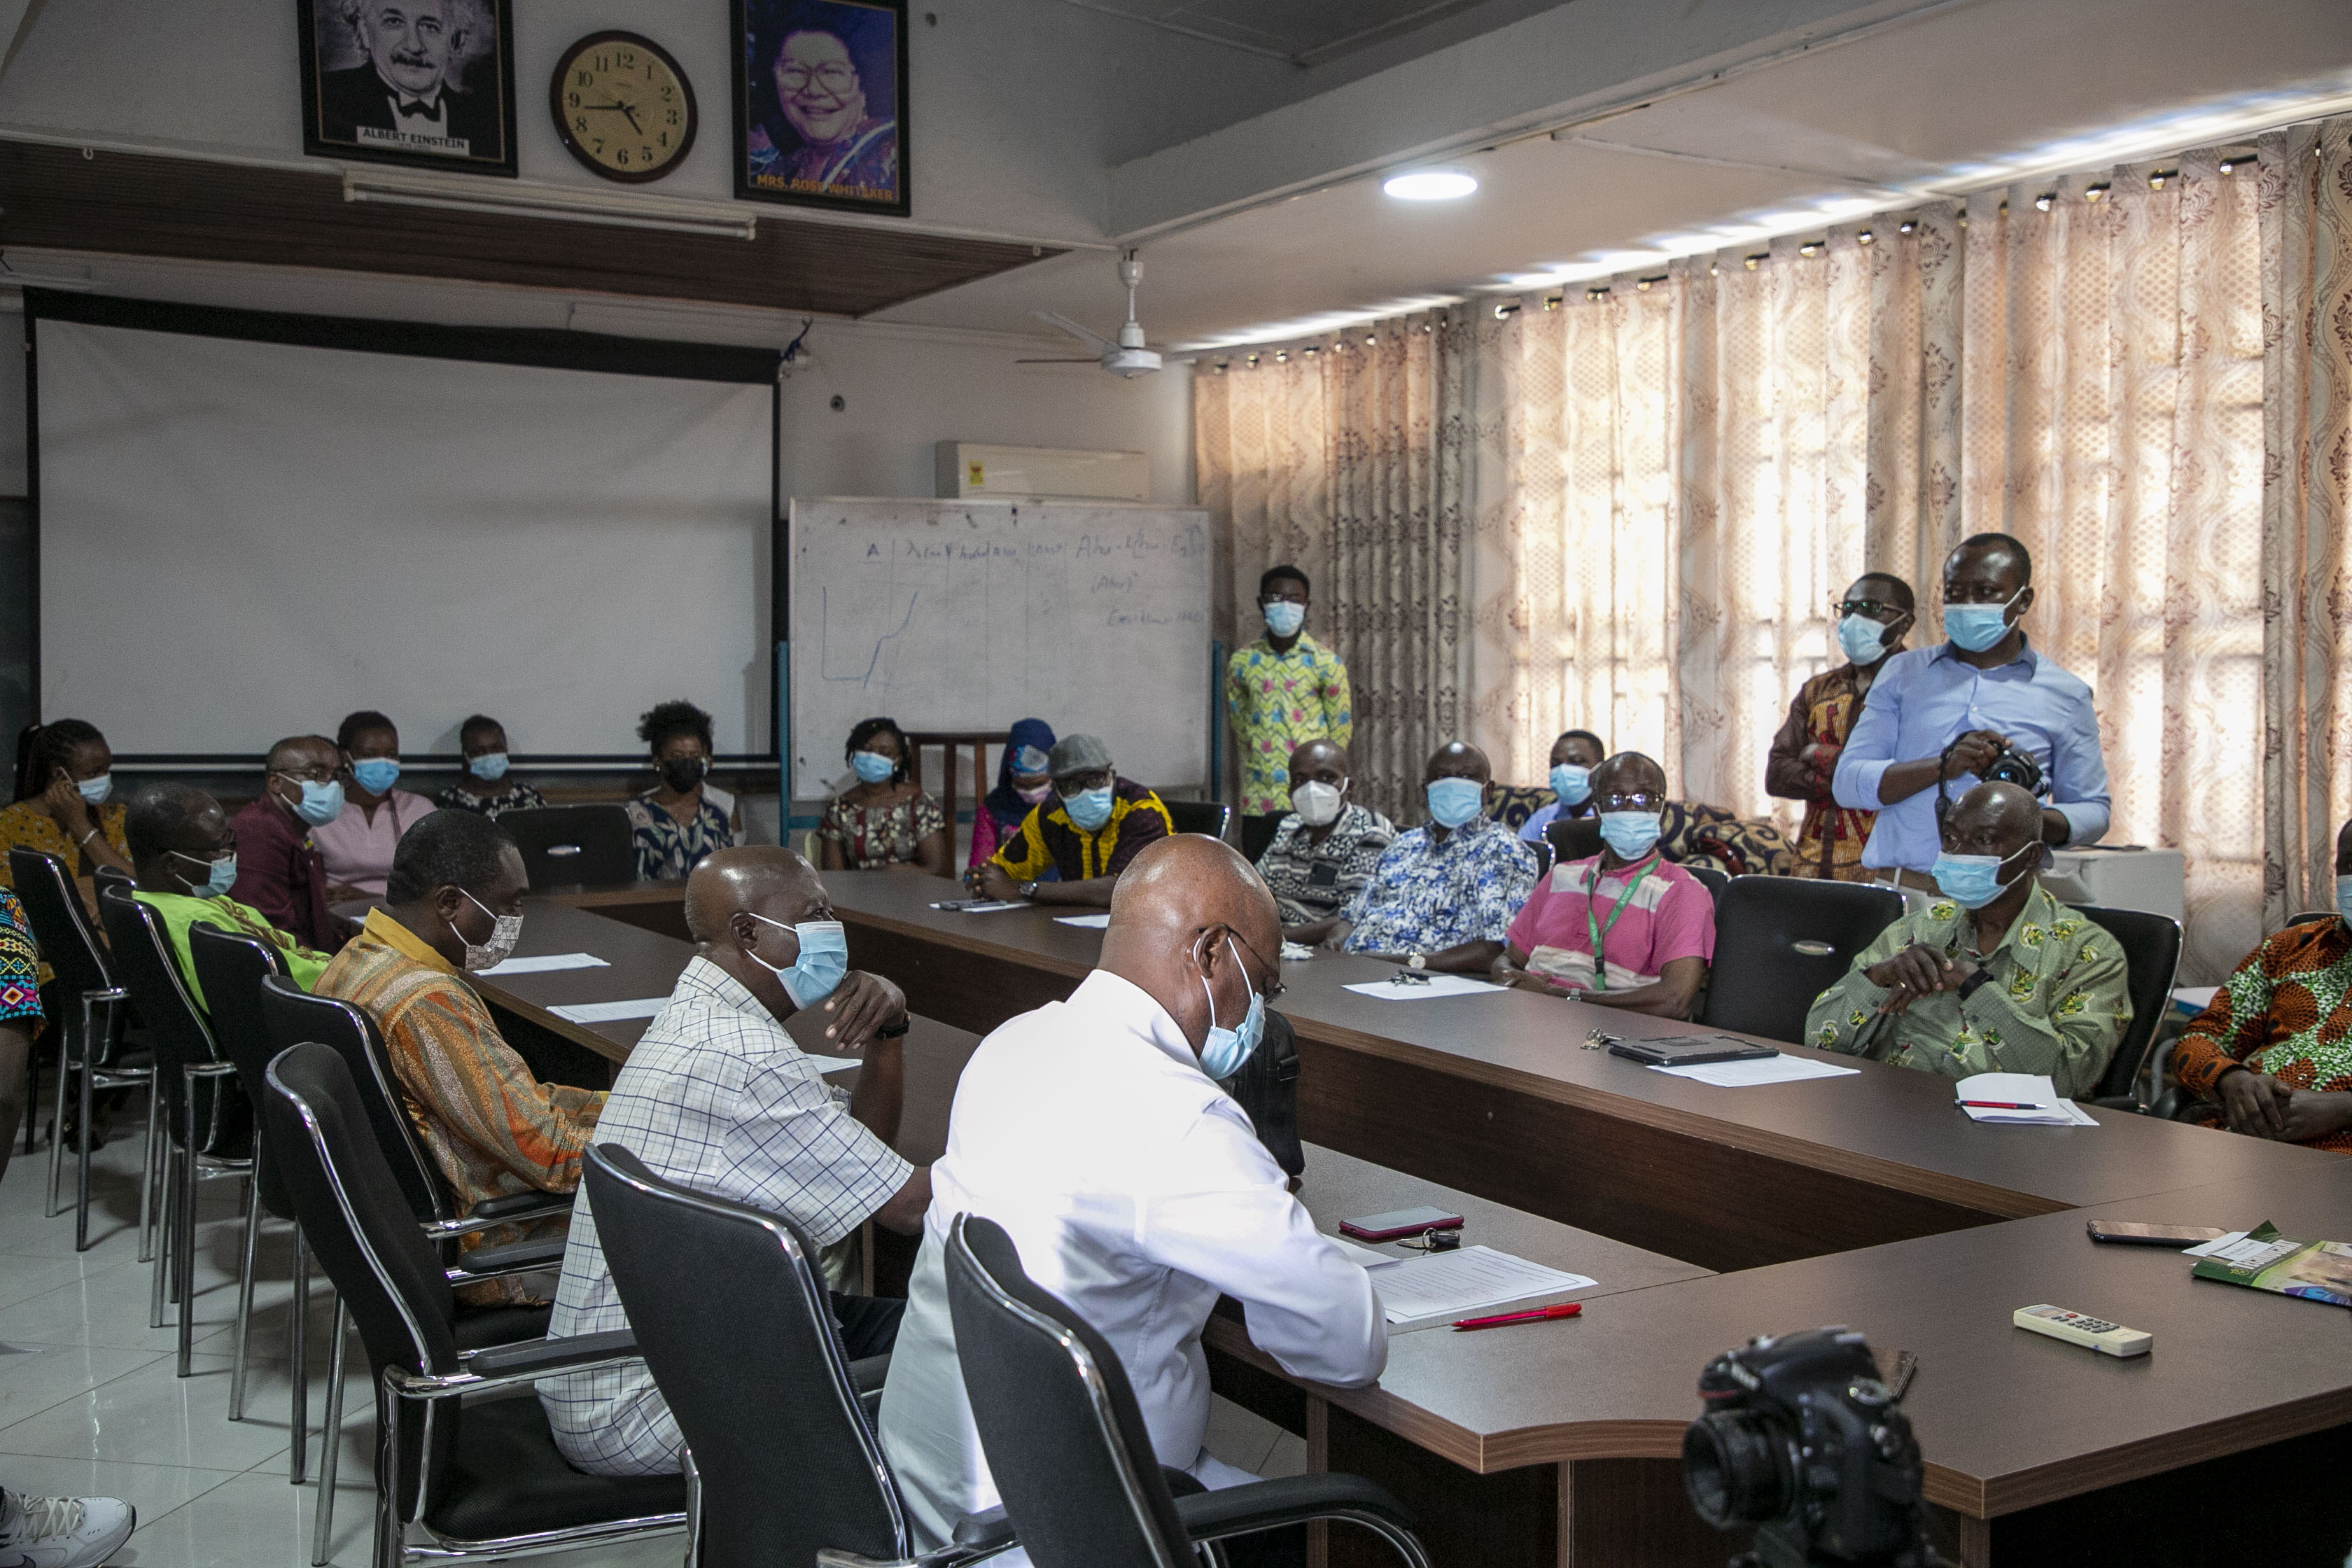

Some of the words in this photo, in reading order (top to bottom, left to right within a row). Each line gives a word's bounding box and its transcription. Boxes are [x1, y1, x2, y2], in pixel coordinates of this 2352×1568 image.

[596, 56, 608, 73] 11
[616, 52, 634, 69] 12
[578, 71, 594, 88] 10
[646, 64, 652, 80] 1
[568, 92, 581, 108] 9
[660, 85, 672, 102] 2
[575, 116, 588, 133] 8
[666, 108, 678, 125] 3
[363, 127, 407, 141] ALBERT
[410, 133, 465, 149] EINSTEIN
[593, 137, 605, 155] 7
[655, 131, 667, 148] 4
[617, 148, 629, 165] 6
[641, 146, 654, 162] 5
[756, 174, 789, 189] MRS.
